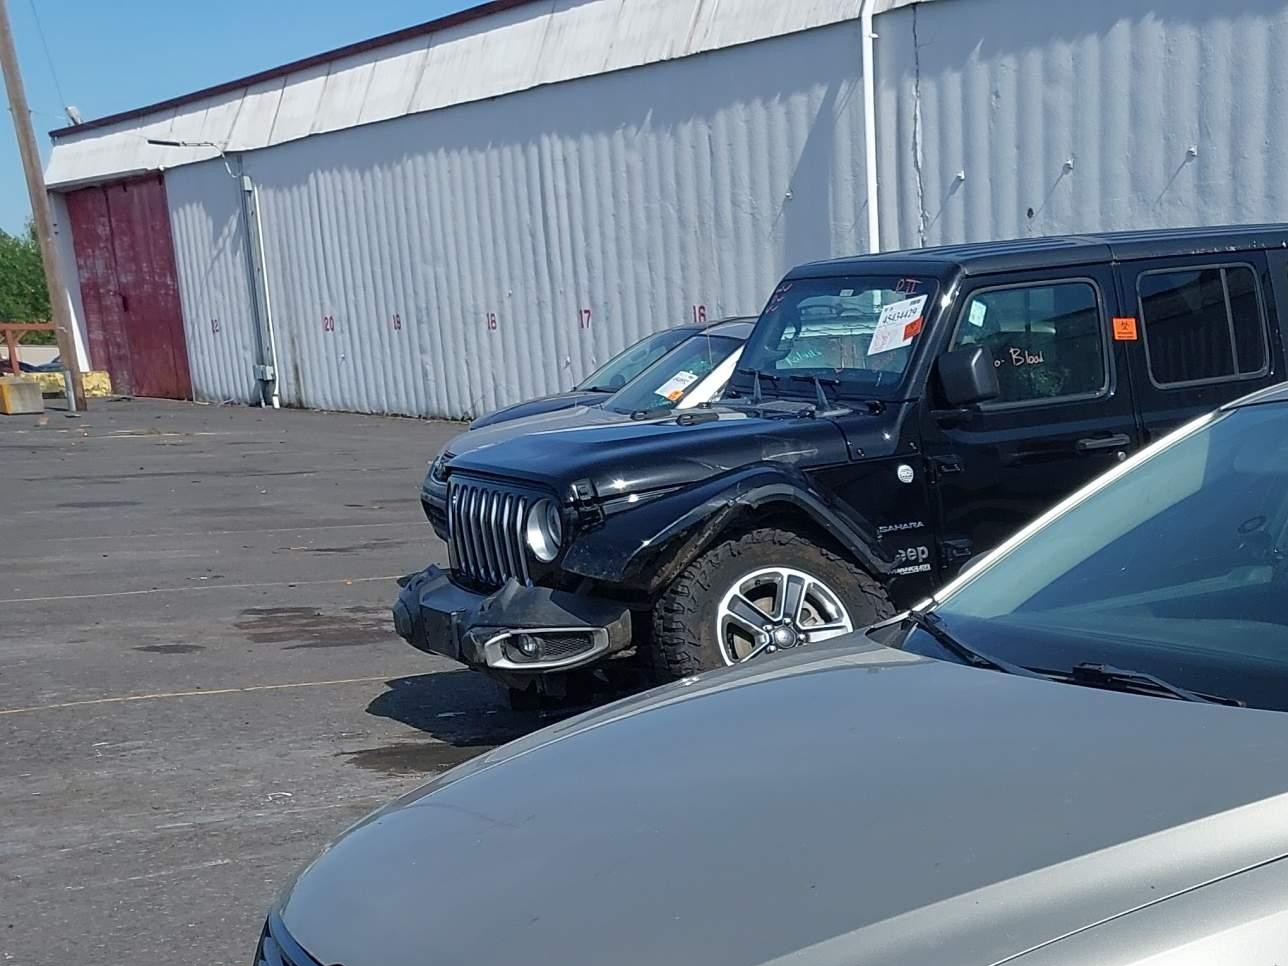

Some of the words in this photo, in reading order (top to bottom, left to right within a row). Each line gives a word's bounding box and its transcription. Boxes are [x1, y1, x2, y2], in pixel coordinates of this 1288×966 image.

[578, 309, 592, 329] 17
[692, 305, 706, 323] 16
[323, 315, 335, 332] 20
[878, 521, 925, 533] SAHARA
[895, 545, 929, 562] eep
